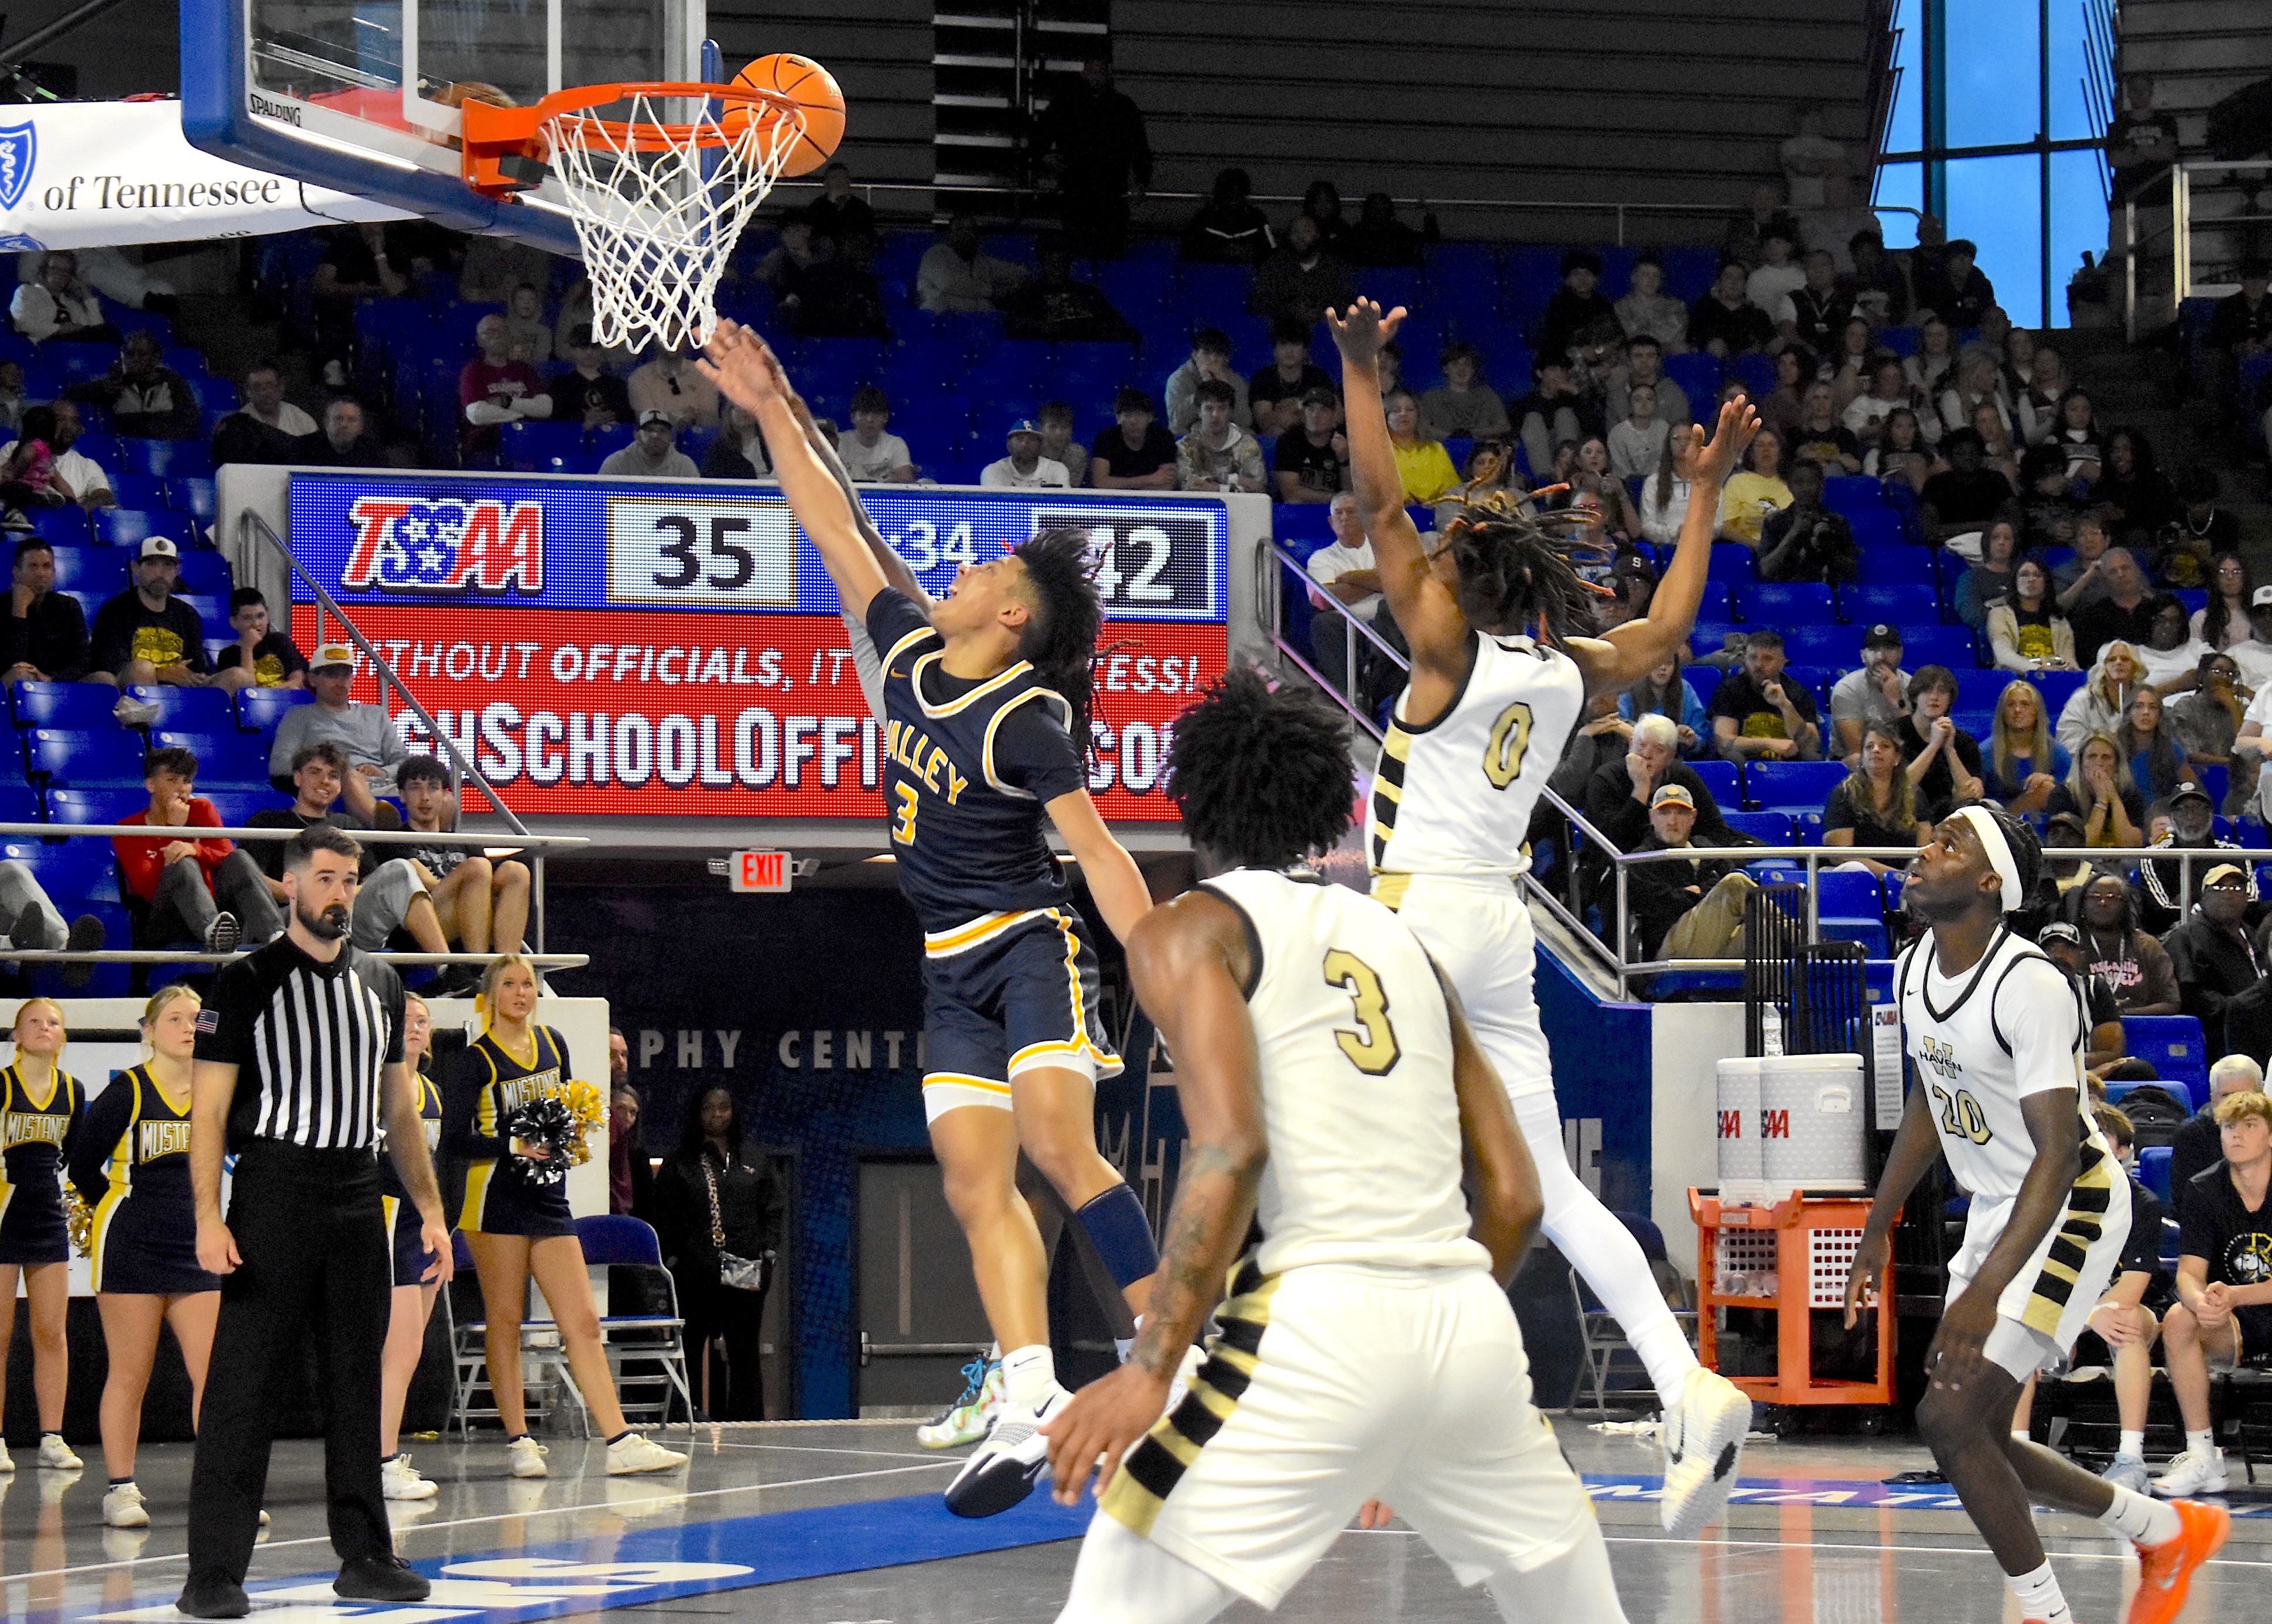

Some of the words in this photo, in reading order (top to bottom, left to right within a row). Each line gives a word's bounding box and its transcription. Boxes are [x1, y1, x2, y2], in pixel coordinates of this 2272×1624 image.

[250, 93, 300, 128] SPALDING
[45, 177, 83, 211] of
[94, 176, 281, 210] Tennessee
[654, 516, 754, 589] 35
[551, 643, 793, 692] OFFICIALS,
[809, 648, 853, 686] IT
[1482, 701, 1535, 791] 0
[892, 779, 920, 846] 3
[742, 853, 784, 887] EXIT
[1323, 948, 1402, 1076] 3
[640, 1030, 742, 1069] PHY
[1919, 1050, 1963, 1072] HAVEN
[1932, 1083, 1993, 1146] 20
